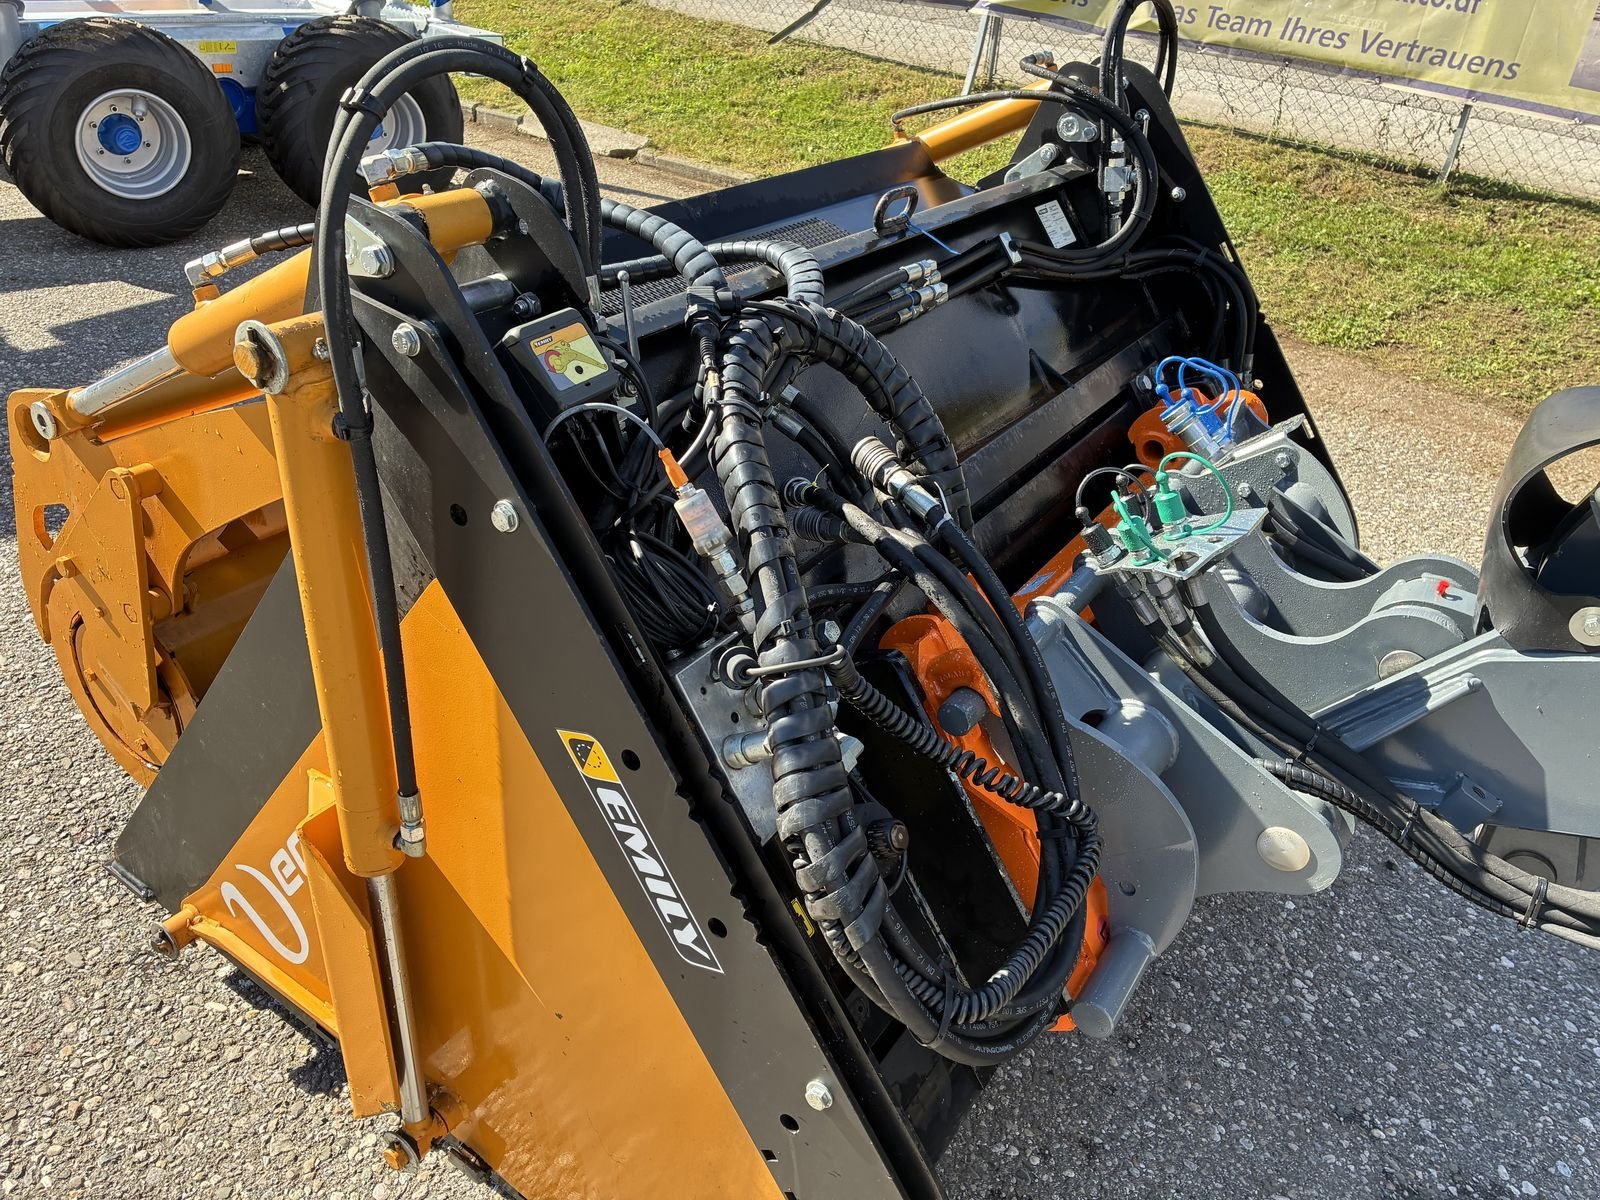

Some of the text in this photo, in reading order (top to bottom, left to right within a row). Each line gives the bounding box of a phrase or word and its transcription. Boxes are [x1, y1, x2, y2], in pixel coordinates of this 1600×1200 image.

[1207, 4, 1272, 37] Team
[1279, 16, 1350, 50] Ihres
[1359, 29, 1522, 81] Vertrauens
[596, 786, 711, 961] EMILY
